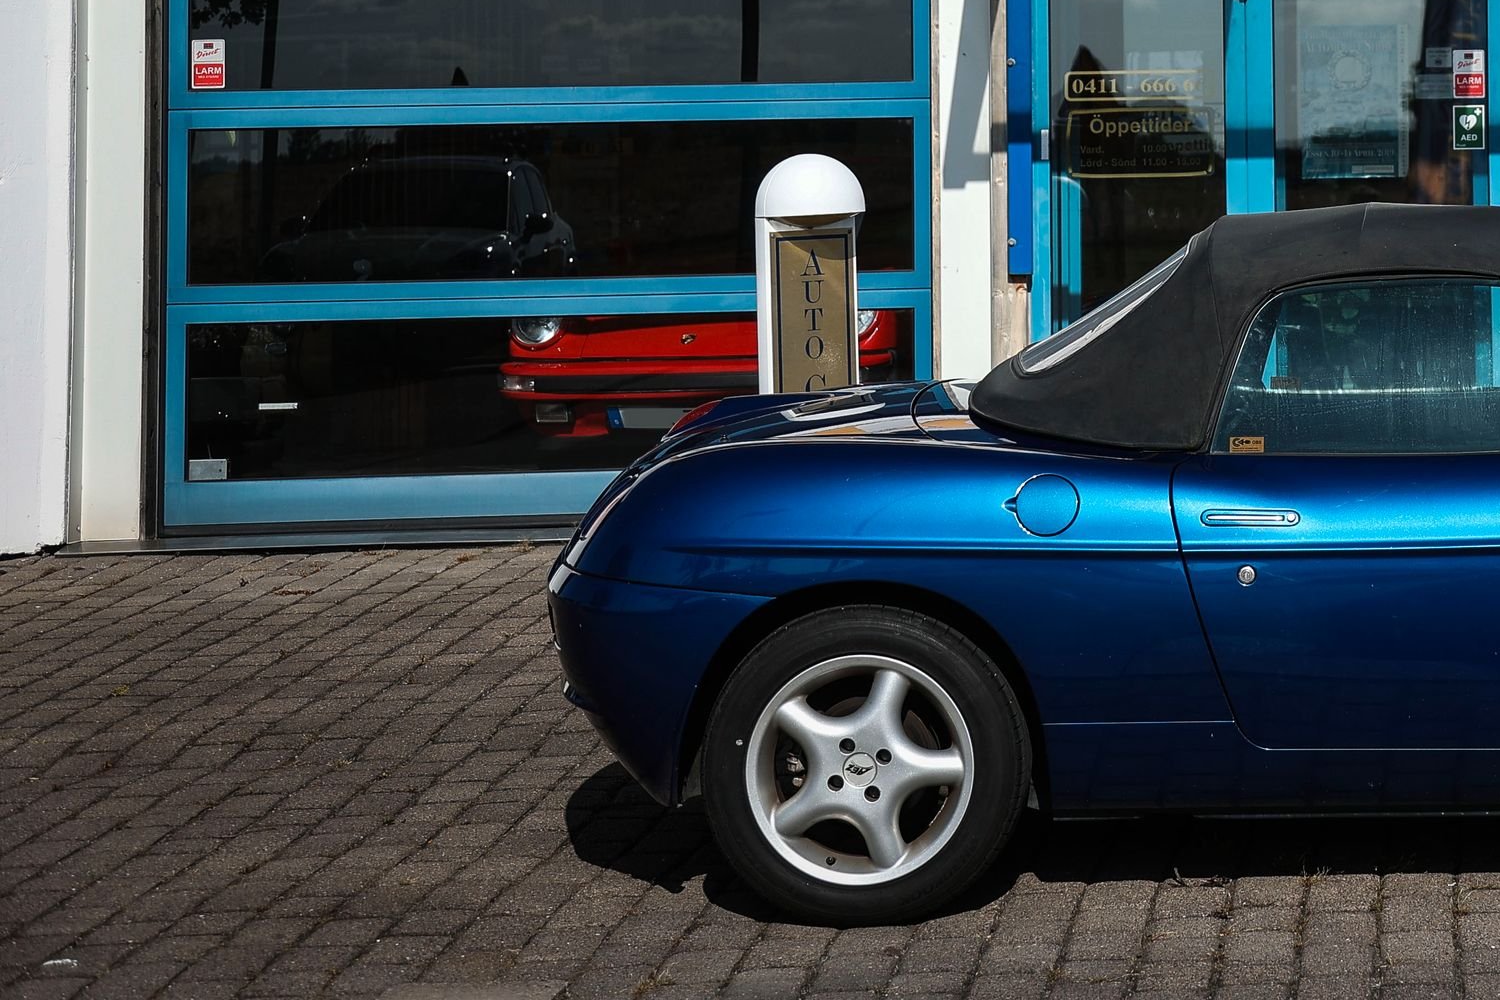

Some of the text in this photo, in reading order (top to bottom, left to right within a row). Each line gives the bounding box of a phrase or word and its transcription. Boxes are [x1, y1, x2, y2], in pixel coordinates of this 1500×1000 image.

[195, 66, 222, 75] LARM
[1072, 78, 1119, 94] 0411
[1140, 78, 1176, 93] 666
[1456, 76, 1482, 85] LARM
[1089, 114, 1191, 138] Öppettider
[1460, 133, 1478, 142] AED
[799, 248, 825, 360] AUTO
